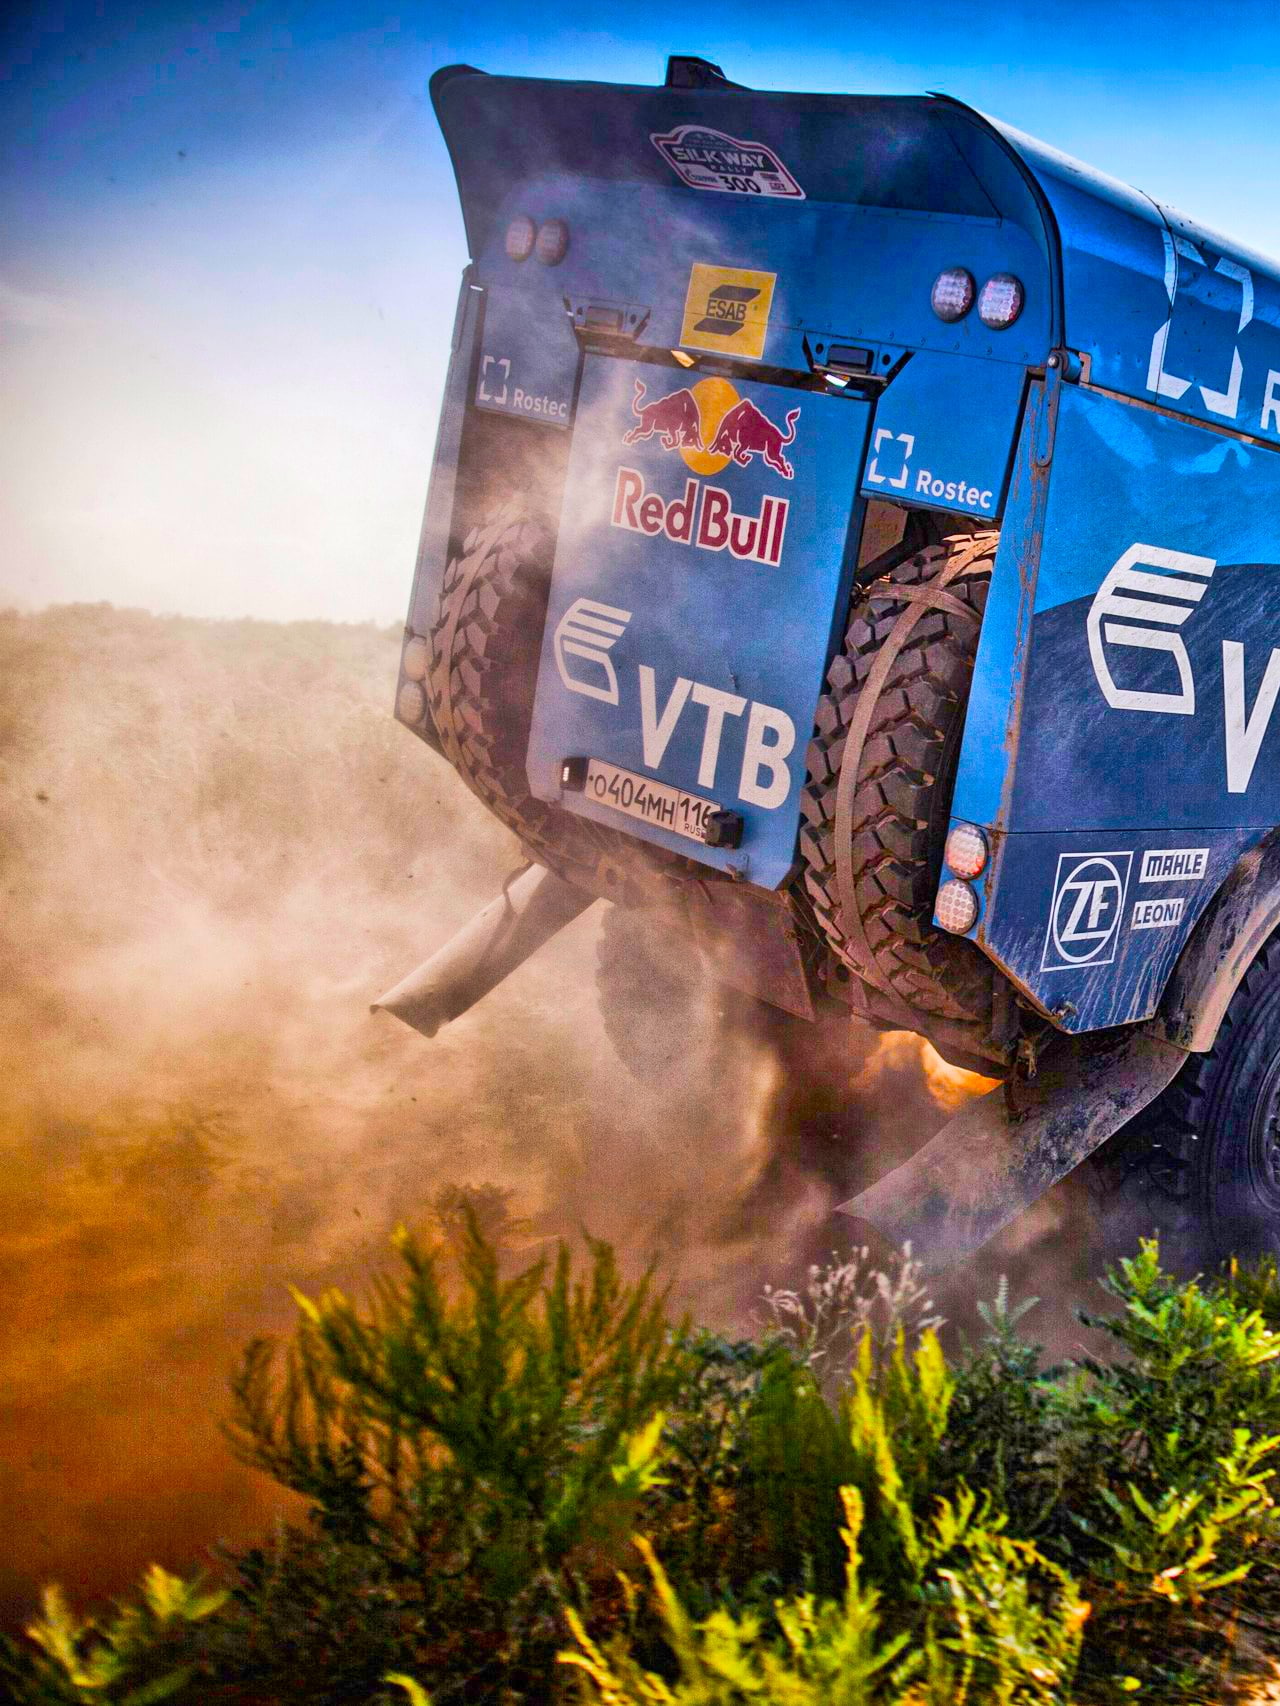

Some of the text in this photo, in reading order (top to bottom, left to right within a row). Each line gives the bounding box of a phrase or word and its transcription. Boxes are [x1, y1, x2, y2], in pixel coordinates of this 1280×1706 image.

[672, 147, 765, 169] SILK WAY
[719, 175, 762, 194] 300
[706, 298, 747, 322] ESAB
[513, 387, 568, 418] Rostec
[915, 469, 993, 509] Rostec
[638, 665, 796, 810] VTB
[684, 822, 702, 837] RUS
[1145, 853, 1204, 878] MAHLE
[1060, 879, 1120, 942] ZF
[1134, 902, 1181, 925] LEONI
